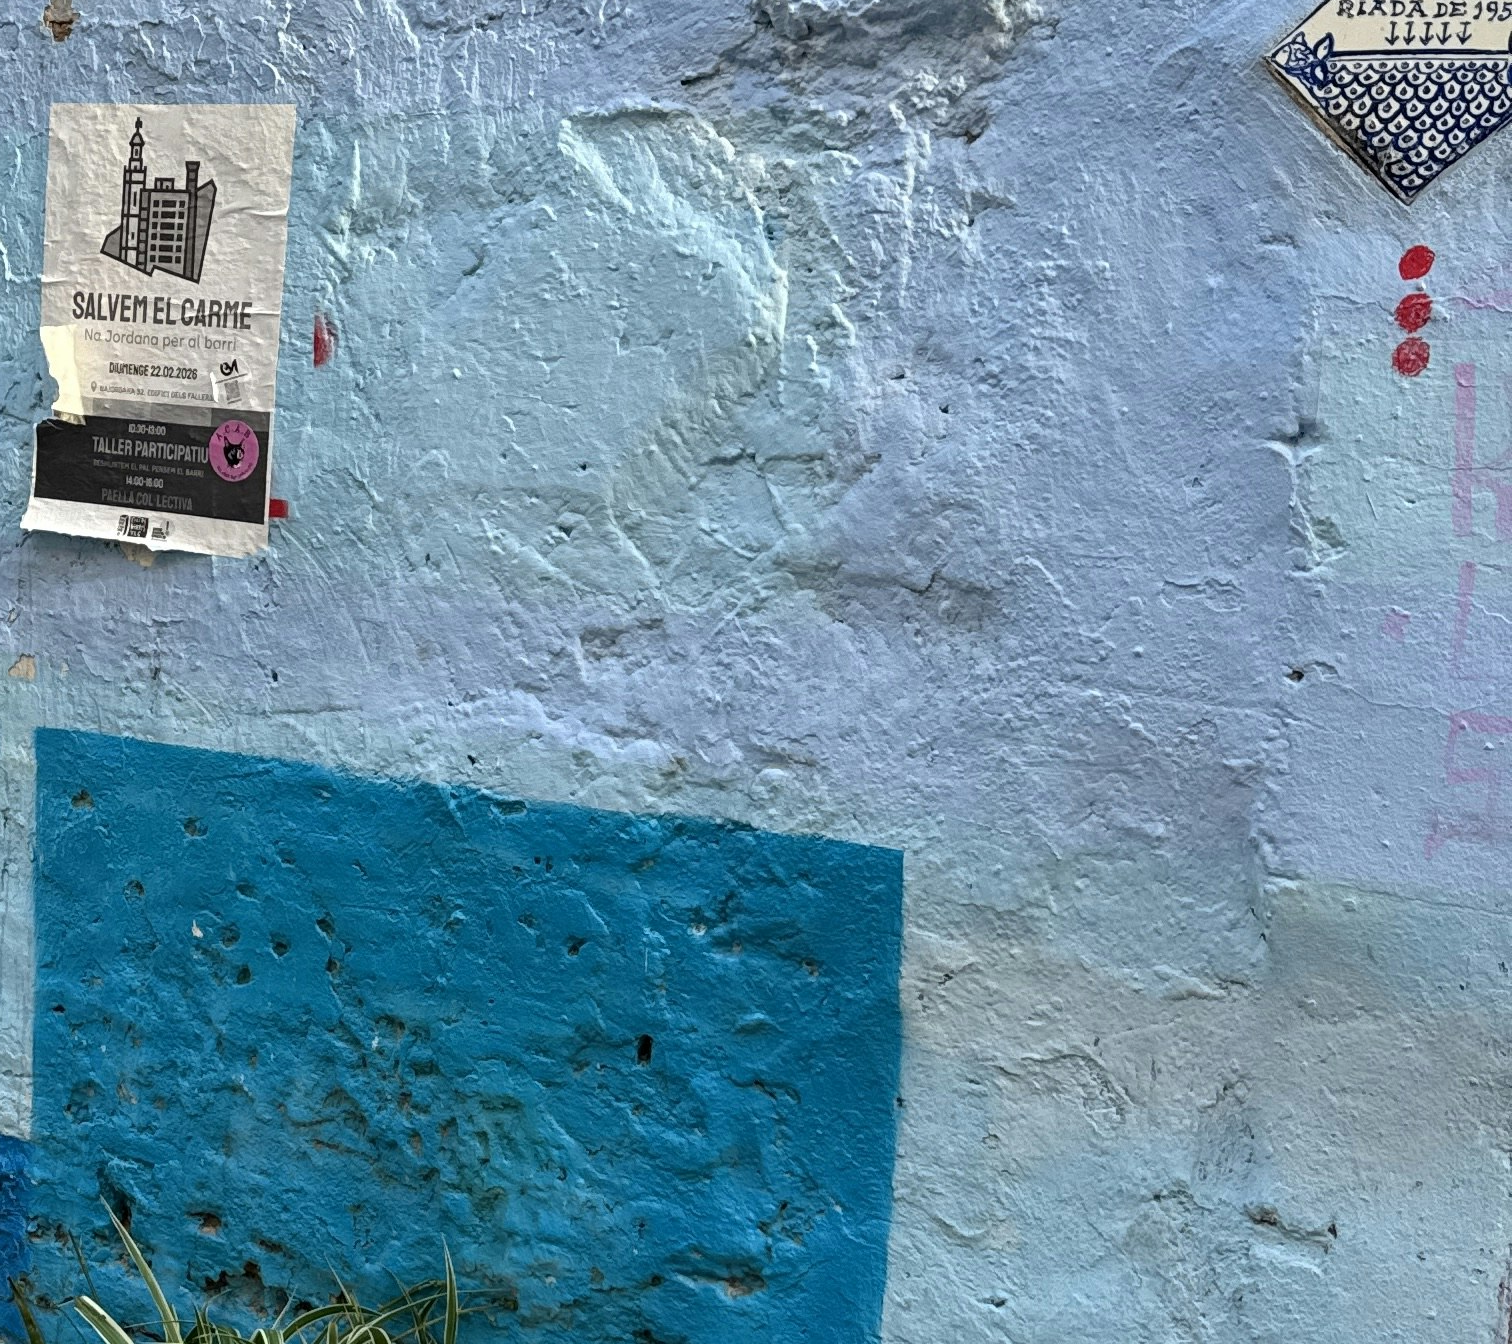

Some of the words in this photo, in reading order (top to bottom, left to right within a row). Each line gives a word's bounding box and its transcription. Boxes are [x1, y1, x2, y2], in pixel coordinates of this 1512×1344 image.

[1432, 0, 1468, 18] DE
[72, 291, 148, 324] SALVEM
[152, 296, 177, 325] EL
[180, 297, 253, 330] CARME
[84, 328, 102, 341] Na
[104, 330, 159, 346] Jordana
[162, 336, 184, 352] per
[187, 335, 201, 349] al
[204, 336, 237, 352] barri
[109, 361, 149, 377] DIUMENGE
[150, 365, 198, 381] 22.02.2026
[92, 436, 133, 457] TALLER
[135, 440, 209, 464] PARTICIPATIU
[101, 487, 135, 505] PAELLA
